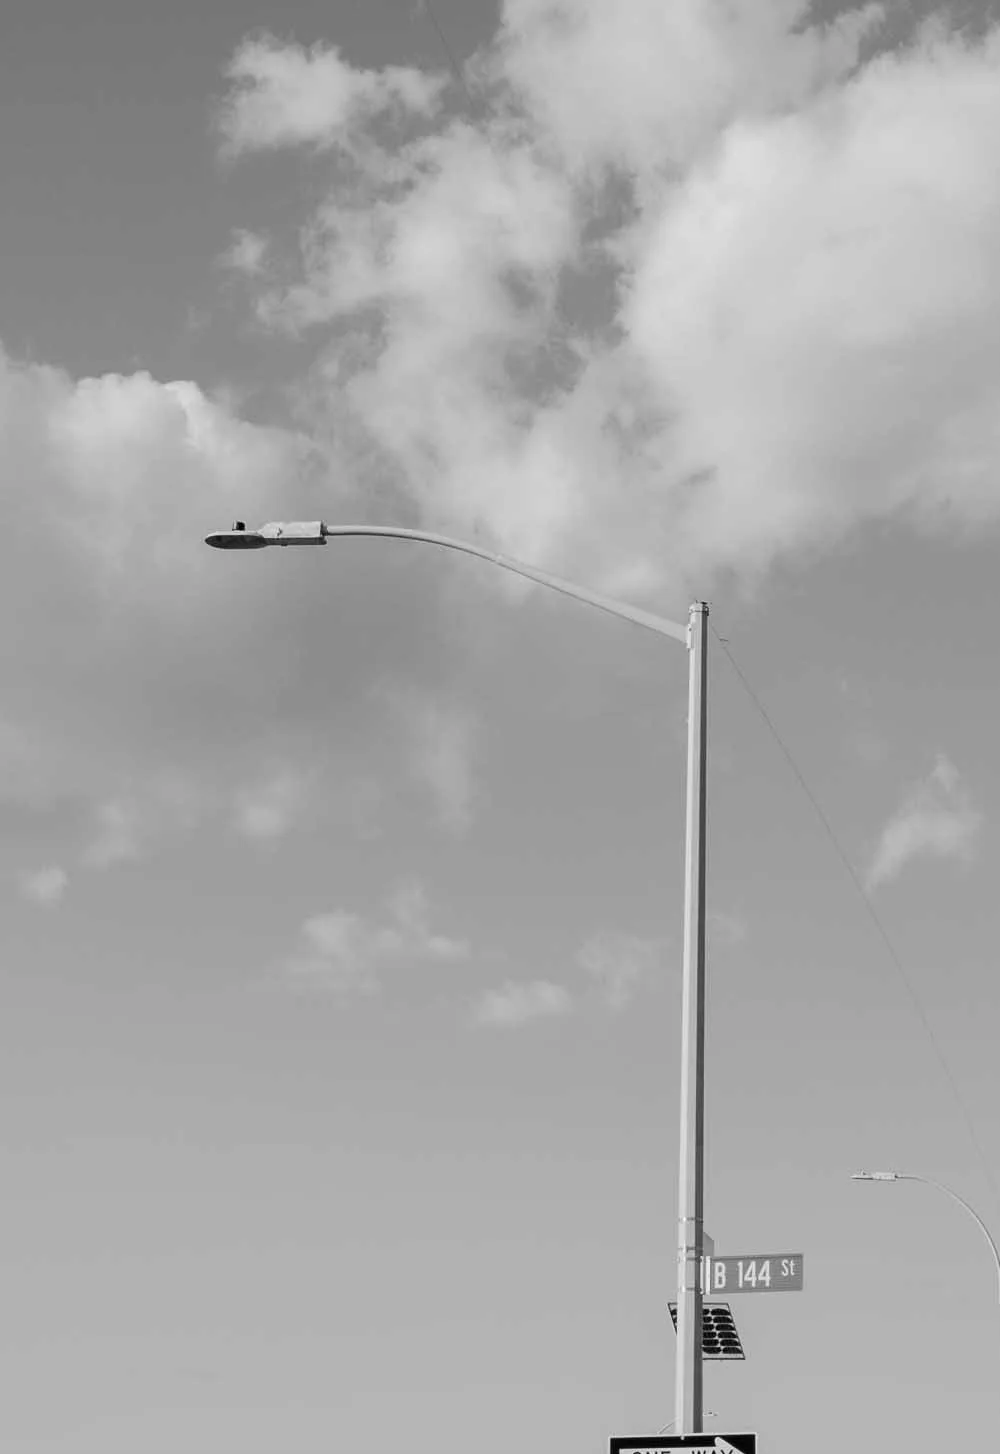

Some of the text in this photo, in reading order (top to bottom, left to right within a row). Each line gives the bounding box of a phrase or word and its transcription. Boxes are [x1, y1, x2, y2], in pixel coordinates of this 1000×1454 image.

[714, 1259, 795, 1288] B 144 St
